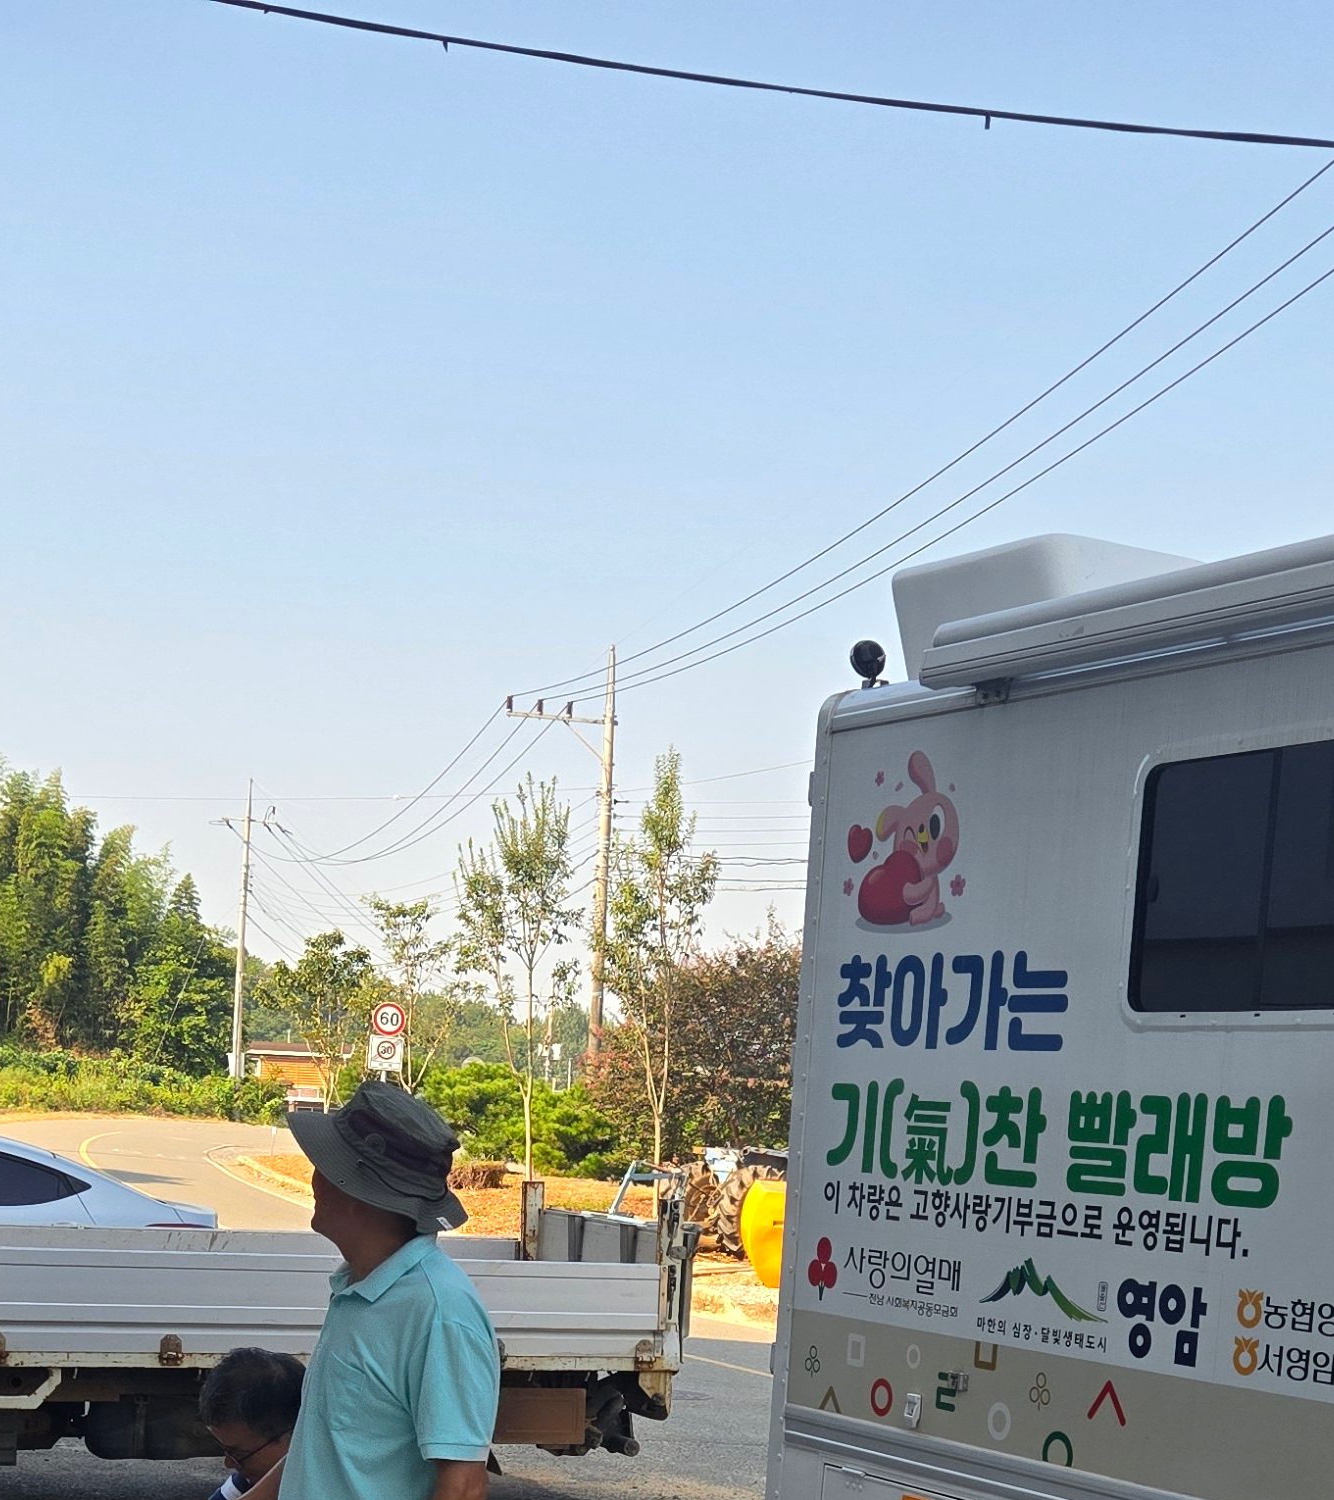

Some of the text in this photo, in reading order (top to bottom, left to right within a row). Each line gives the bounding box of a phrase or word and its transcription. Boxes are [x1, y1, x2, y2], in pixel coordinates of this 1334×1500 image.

[380, 1011, 399, 1026] 60
[836, 950, 1068, 1051] 찾아가는
[380, 1045, 392, 1054] 30
[826, 1078, 1293, 1209] 기(氣)찬 빨래방
[824, 1181, 1249, 1259] 이 차량은 고향사랑기부금으로 운영됩니다.
[843, 1246, 962, 1296] 사랑의열매
[976, 1316, 1007, 1336] 마한의
[1117, 1277, 1208, 1368] 영암
